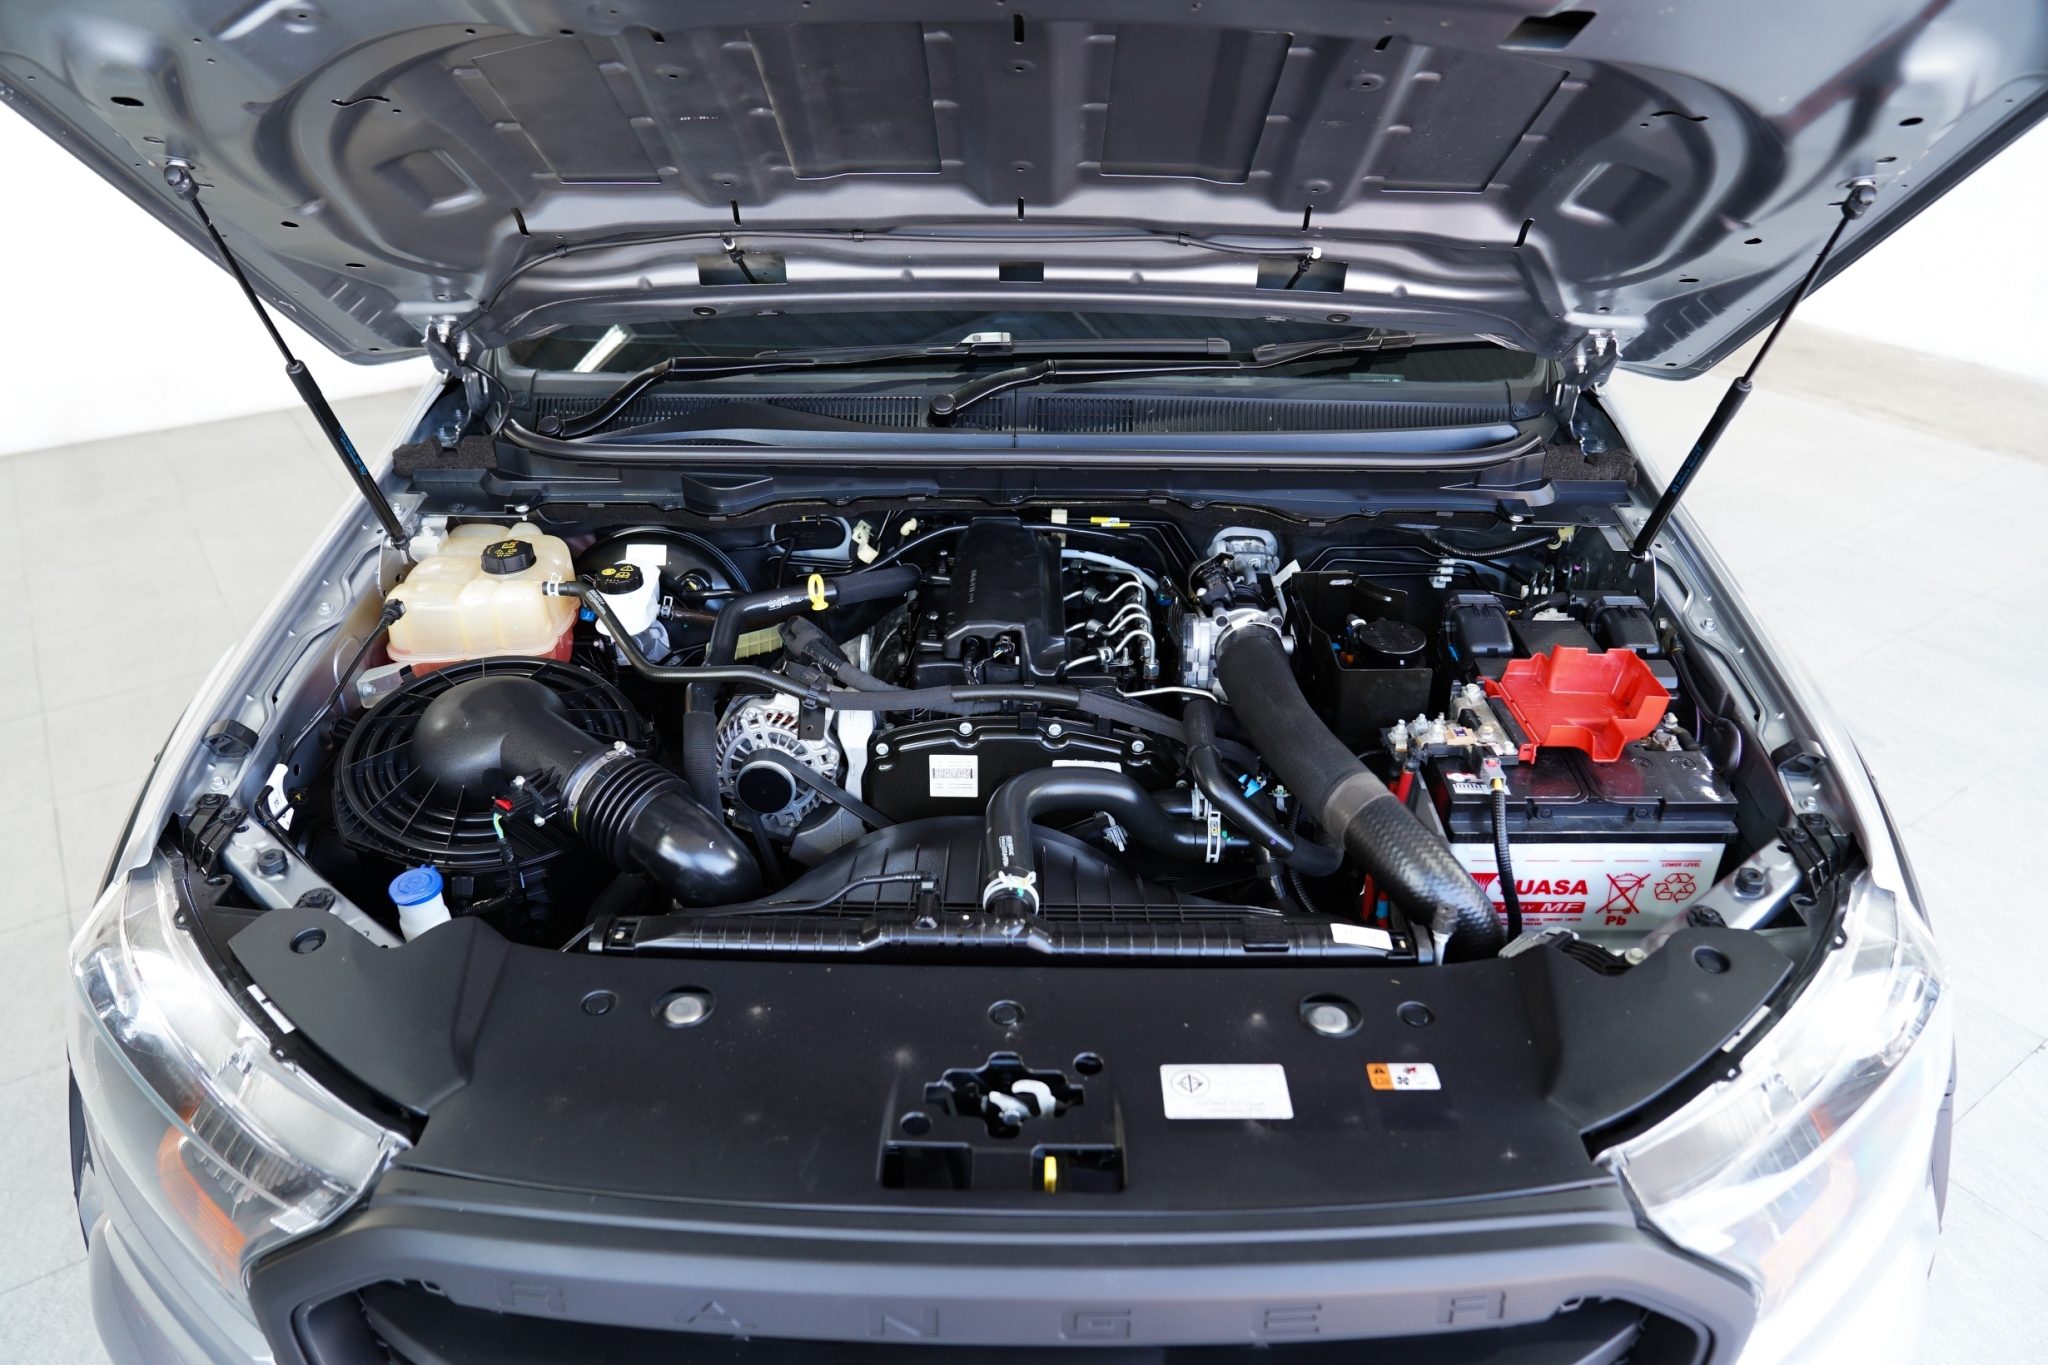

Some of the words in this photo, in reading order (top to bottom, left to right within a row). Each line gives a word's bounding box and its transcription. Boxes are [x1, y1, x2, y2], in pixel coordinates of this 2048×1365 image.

[1540, 902, 1582, 912] MF
[1605, 915, 1627, 926] Pb
[500, 1281, 1506, 1341] RANGER
